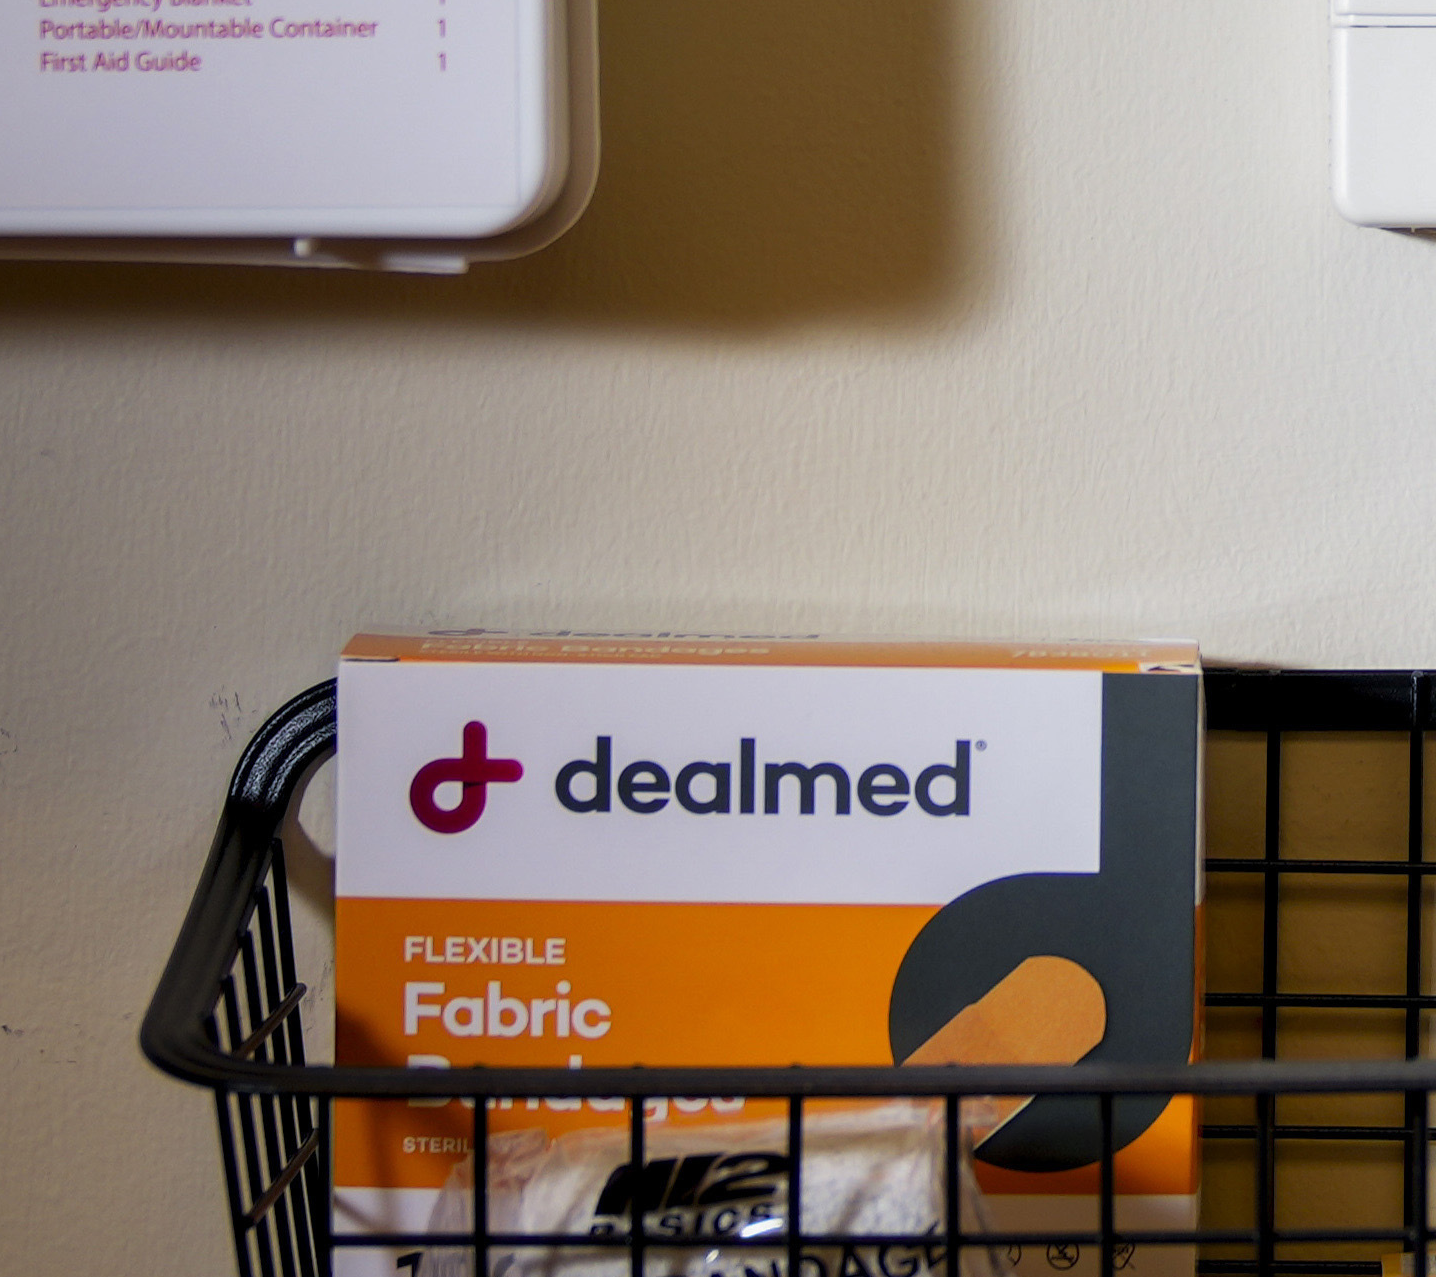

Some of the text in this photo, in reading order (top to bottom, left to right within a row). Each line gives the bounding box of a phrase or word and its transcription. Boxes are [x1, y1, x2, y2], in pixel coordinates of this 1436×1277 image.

[39, 50, 447, 73] First Aid Guide 1
[554, 735, 971, 818] dealmed
[403, 935, 566, 966] FLEXIBLE
[403, 980, 612, 1040] Fabric
